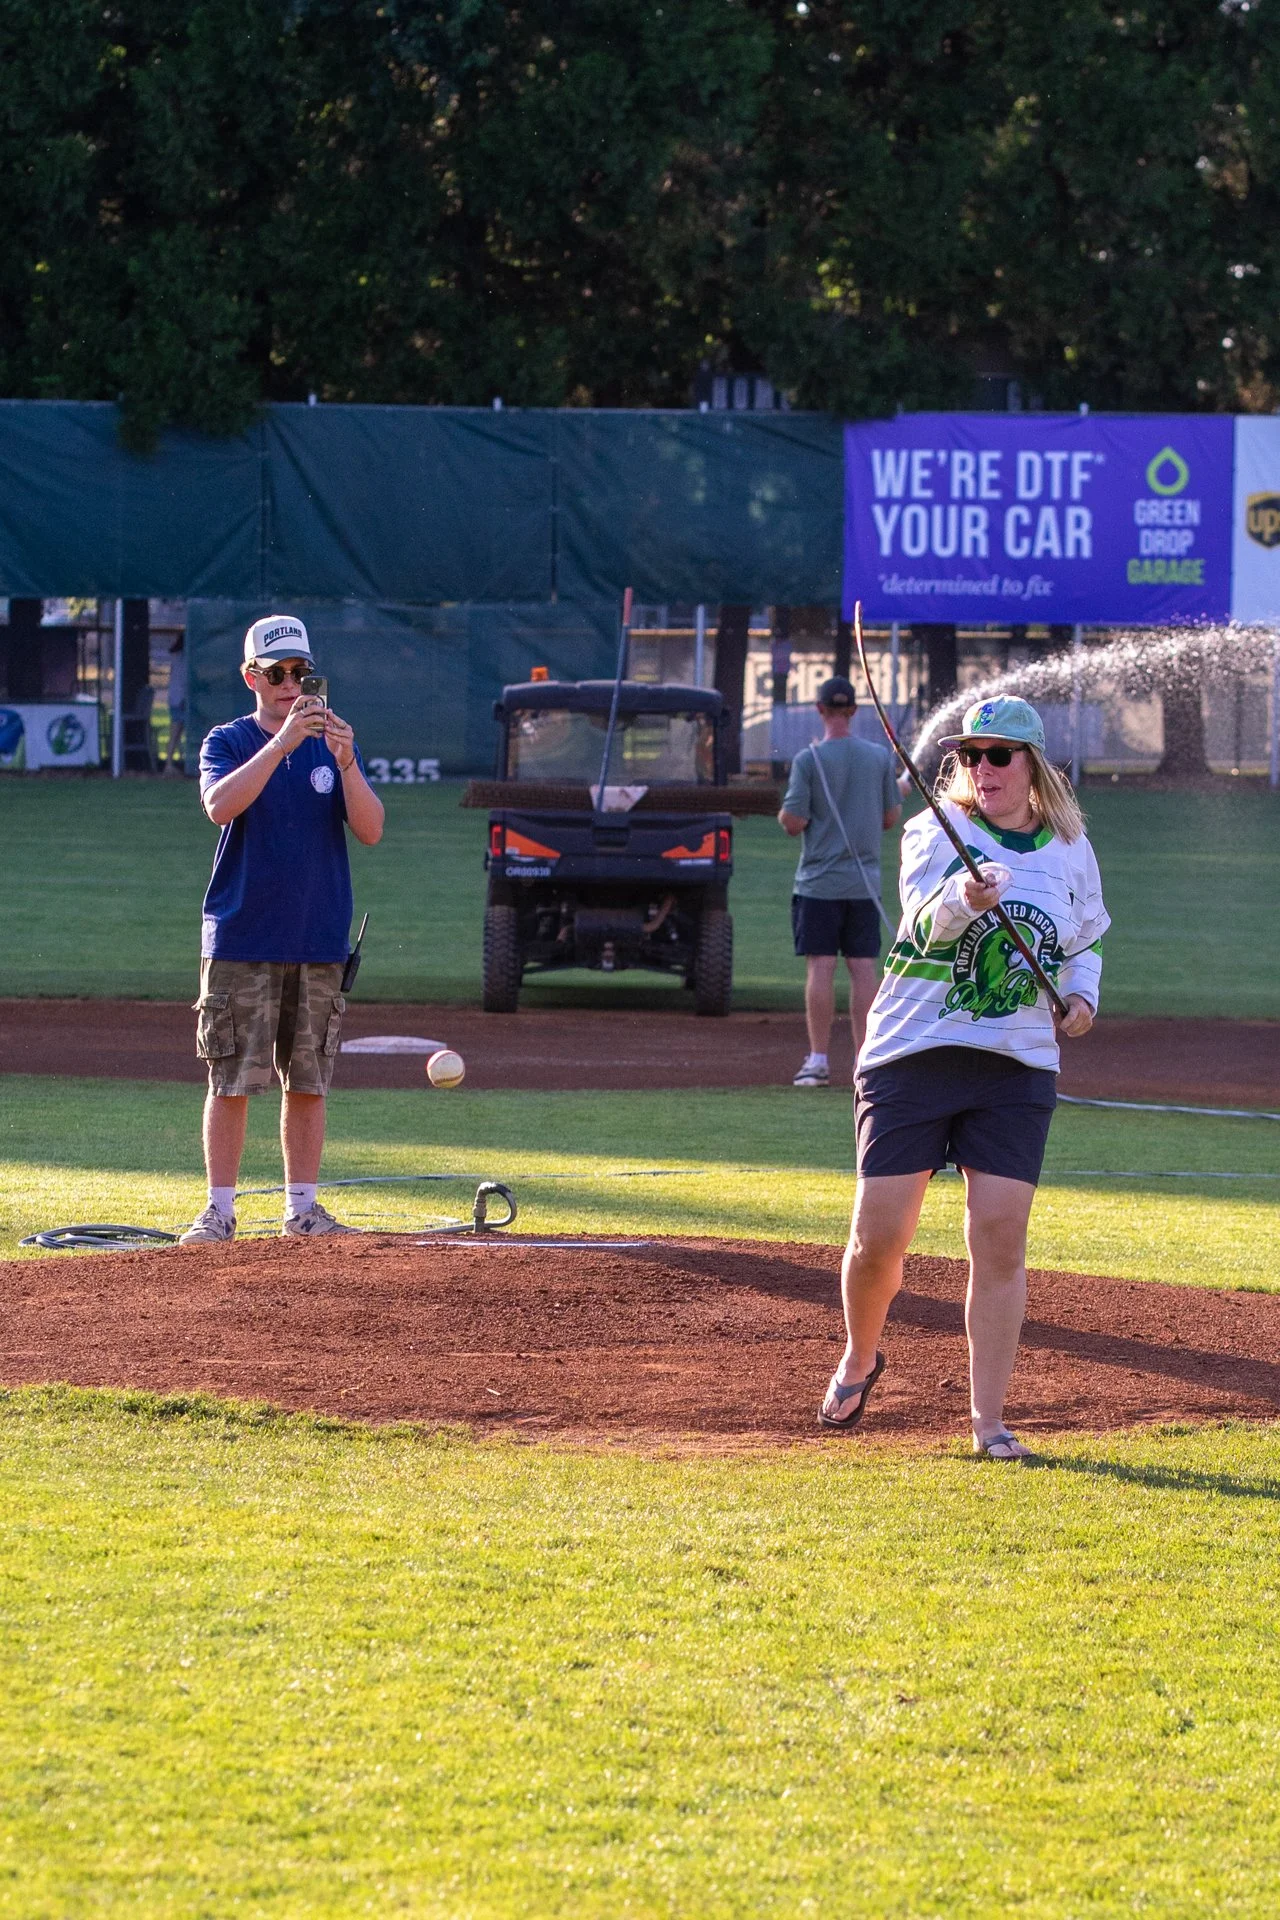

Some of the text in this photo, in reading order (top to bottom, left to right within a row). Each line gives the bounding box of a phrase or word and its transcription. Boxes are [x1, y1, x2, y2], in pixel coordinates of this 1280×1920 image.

[871, 448, 1002, 500] WE'RE
[1134, 499, 1200, 526] GREEN
[1249, 509, 1280, 542] up
[872, 504, 1093, 559] YOUR CAR
[1139, 529, 1194, 556] DROP
[1127, 558, 1205, 586] GARAGE
[1001, 575, 1022, 596] to
[1021, 574, 1055, 601] fix
[264, 626, 302, 644] PORTLAND
[368, 758, 441, 783] 335
[956, 904, 1055, 974] PORTLAND UNTED HOCKEY
